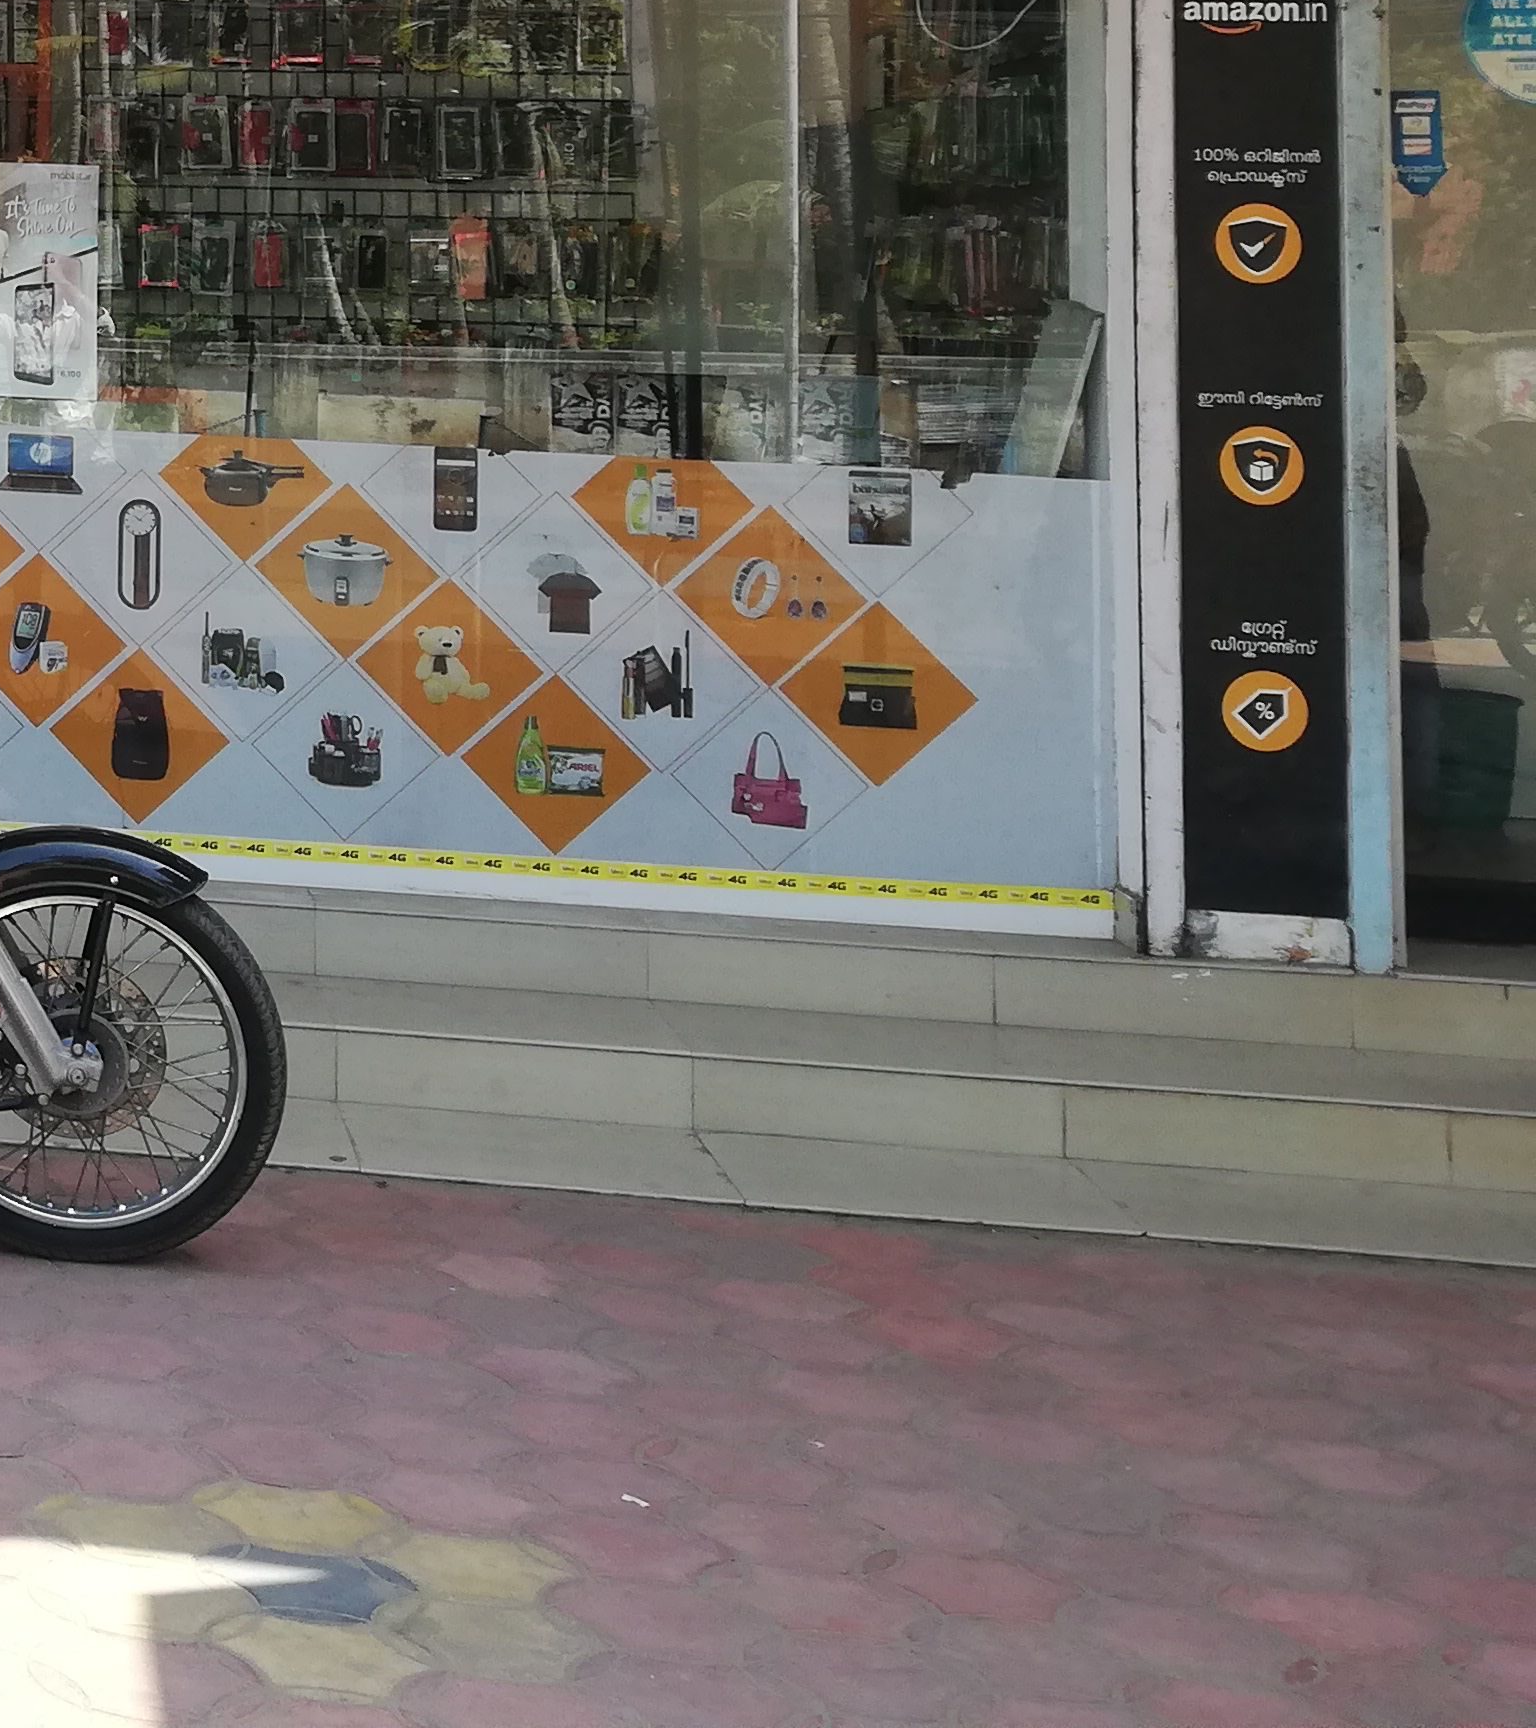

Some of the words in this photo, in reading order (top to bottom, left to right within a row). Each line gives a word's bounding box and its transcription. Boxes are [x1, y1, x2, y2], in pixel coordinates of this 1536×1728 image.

[1193, 148, 1239, 163] 100%
[630, 869, 648, 878] 4G
[778, 878, 796, 887] 4G
[928, 886, 947, 896] 4G
[1080, 894, 1100, 903] 4G
